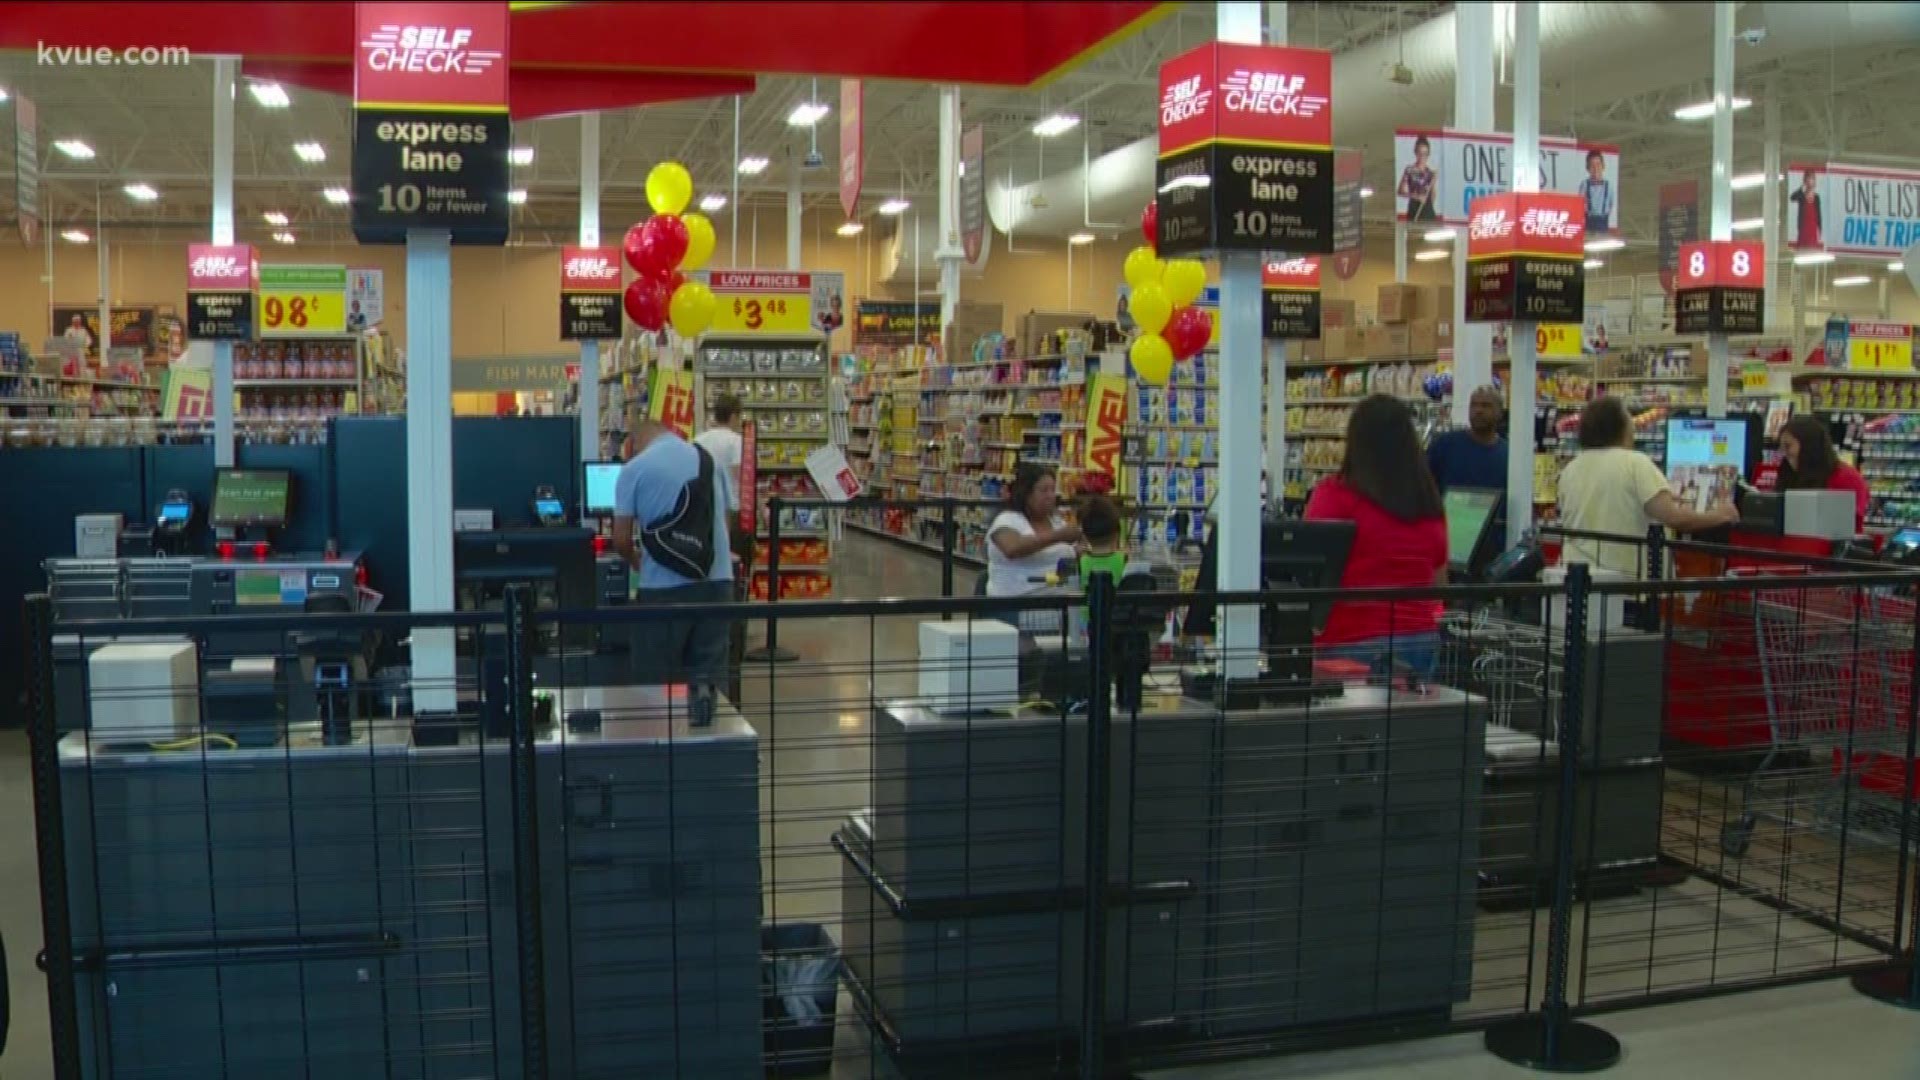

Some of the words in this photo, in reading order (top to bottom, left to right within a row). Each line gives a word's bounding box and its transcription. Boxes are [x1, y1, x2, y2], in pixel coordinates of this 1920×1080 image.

[400, 26, 472, 49] SELF
[369, 48, 466, 73] CHECK
[1174, 75, 1201, 101] SELF
[1250, 72, 1305, 94] SELF
[1163, 99, 1198, 126] CHECK
[1225, 91, 1300, 115] CHECK
[376, 122, 488, 145] express
[402, 146, 463, 171] lane
[1231, 155, 1318, 177] express
[1463, 143, 1507, 186] ONE
[1539, 149, 1560, 189] ST
[377, 184, 422, 213] 10
[1252, 178, 1299, 201] lane
[1844, 178, 1880, 216] ONE
[426, 203, 443, 212] or
[447, 201, 488, 213] fewer
[1537, 210, 1569, 224] SELF
[1234, 211, 1267, 236] 10
[1522, 222, 1566, 237] CHECK
[1843, 217, 1880, 246] ONE
[1525, 262, 1575, 276] express
[1690, 251, 1705, 277] 8
[1732, 250, 1750, 277] 8
[721, 274, 752, 287] LOW
[755, 274, 800, 288] PRICES
[1536, 276, 1564, 290] lane
[1526, 295, 1546, 313] 10
[1722, 298, 1758, 312] LANE
